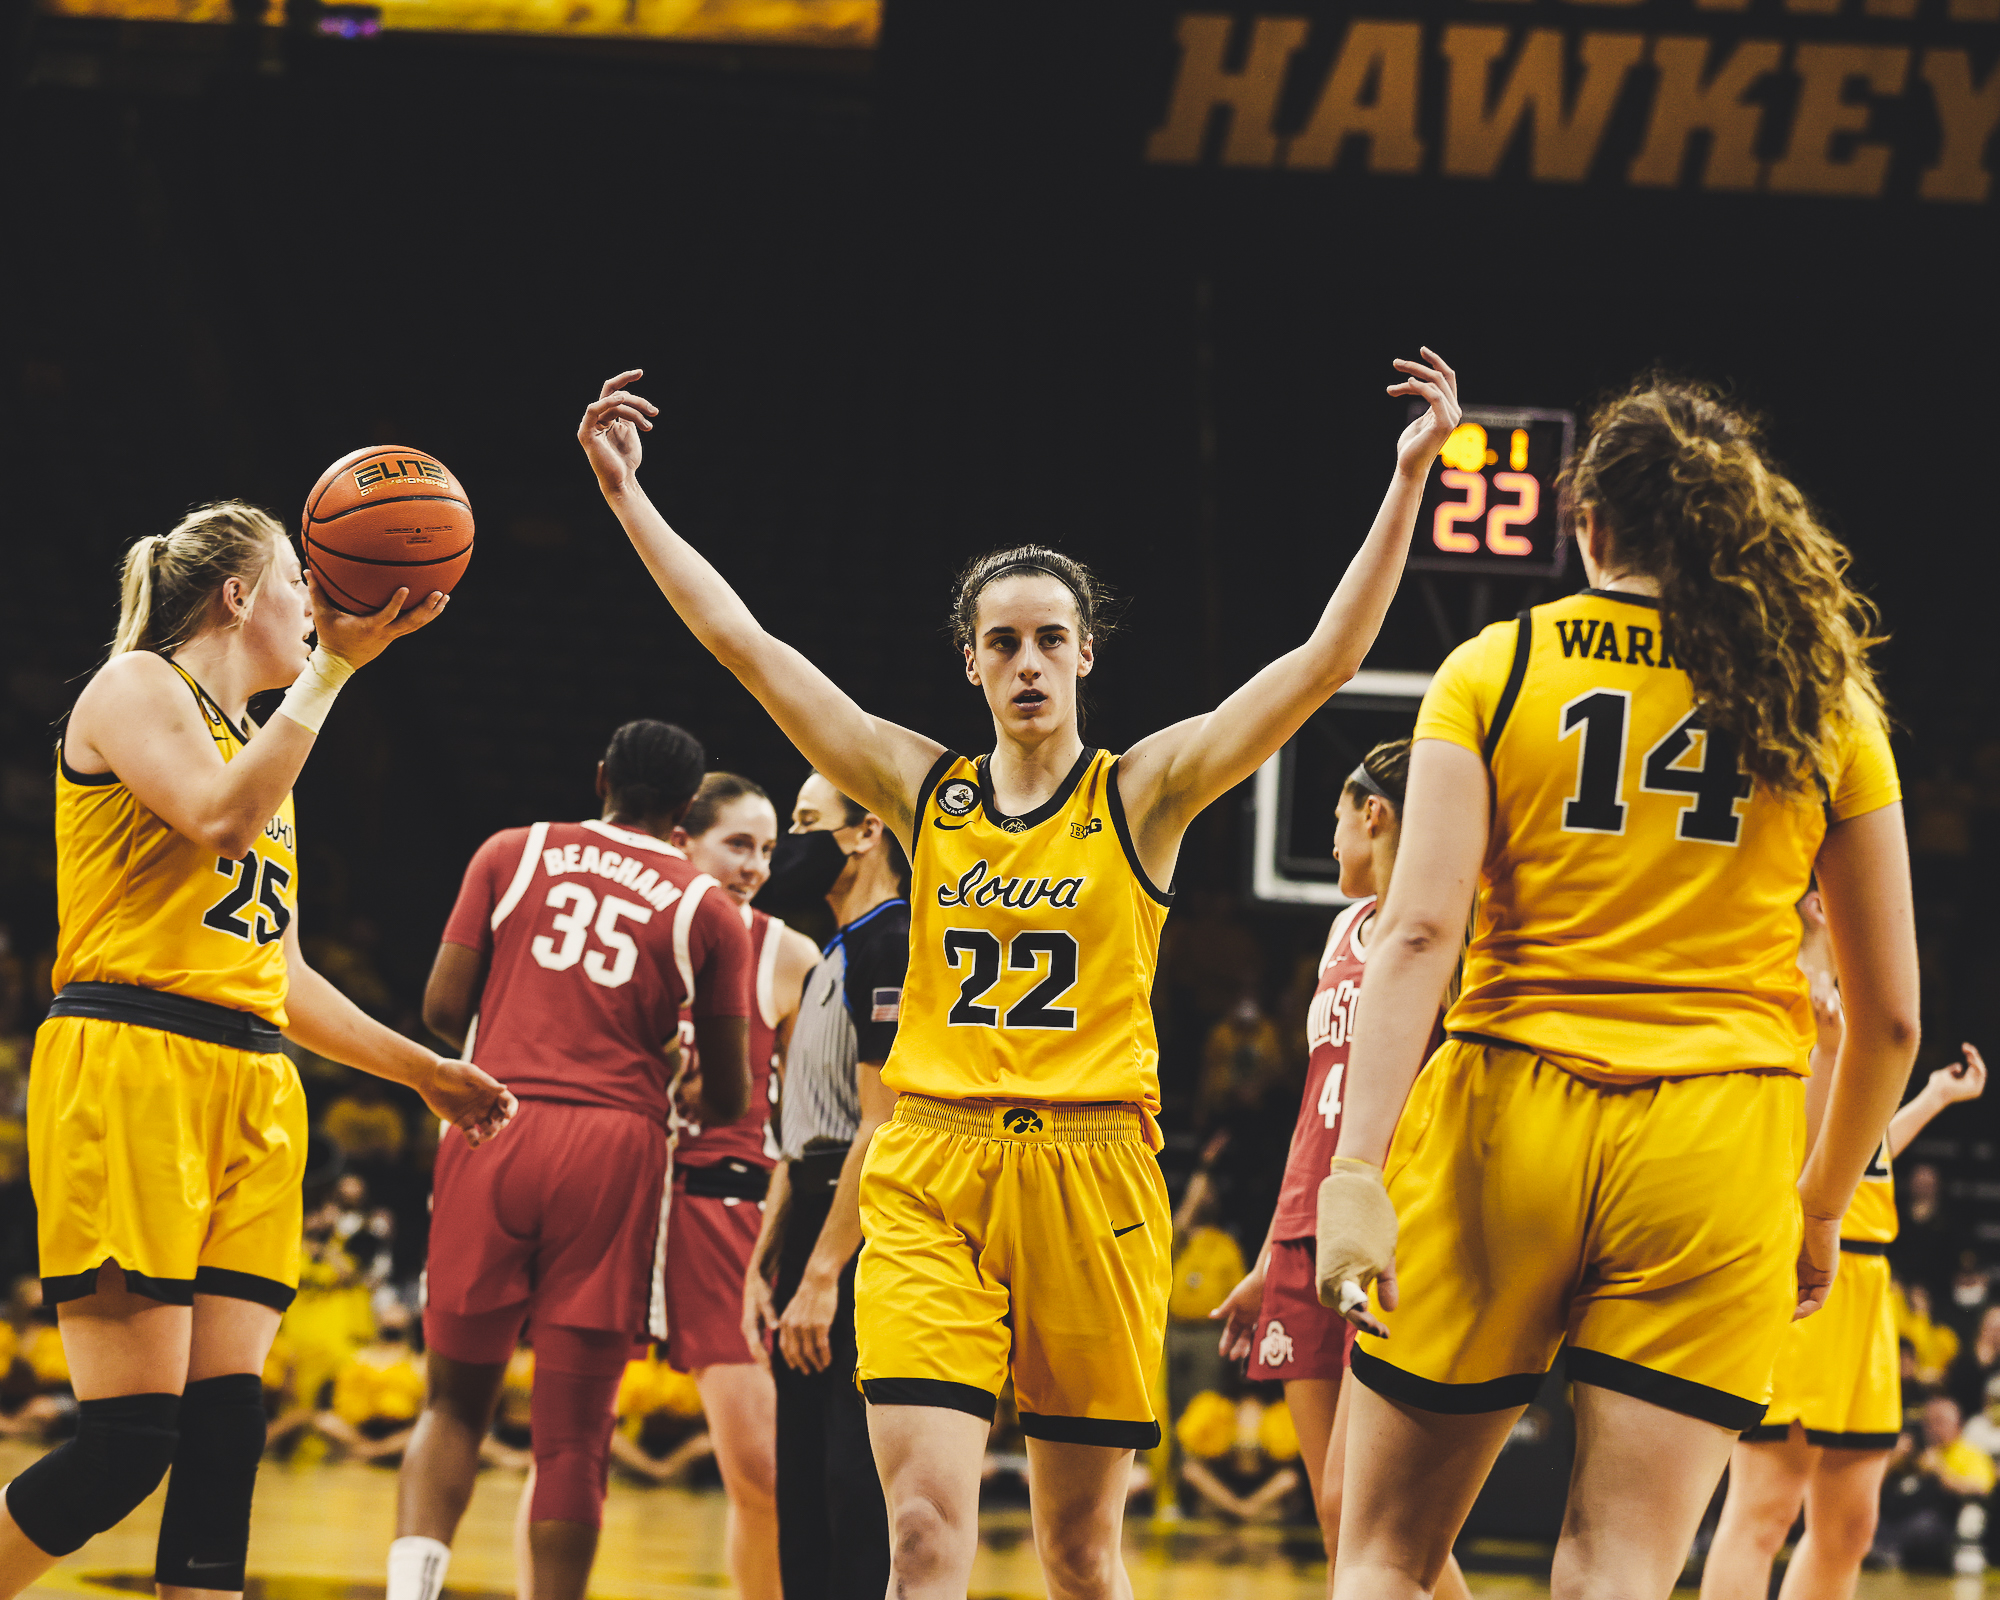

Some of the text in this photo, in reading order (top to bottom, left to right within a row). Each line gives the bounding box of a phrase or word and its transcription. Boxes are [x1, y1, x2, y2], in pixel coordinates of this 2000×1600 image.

[1147, 14, 2000, 203] HAWKEY
[353, 459, 447, 490] ELITE
[1433, 469, 1540, 556] 22
[1558, 686, 1752, 847] 14
[202, 847, 293, 945] 25
[542, 844, 683, 912] BEACHAM
[937, 859, 1086, 909] Iowa
[531, 881, 653, 988] 35
[943, 926, 1079, 1031] 22
[1317, 1063, 1345, 1129] 4
